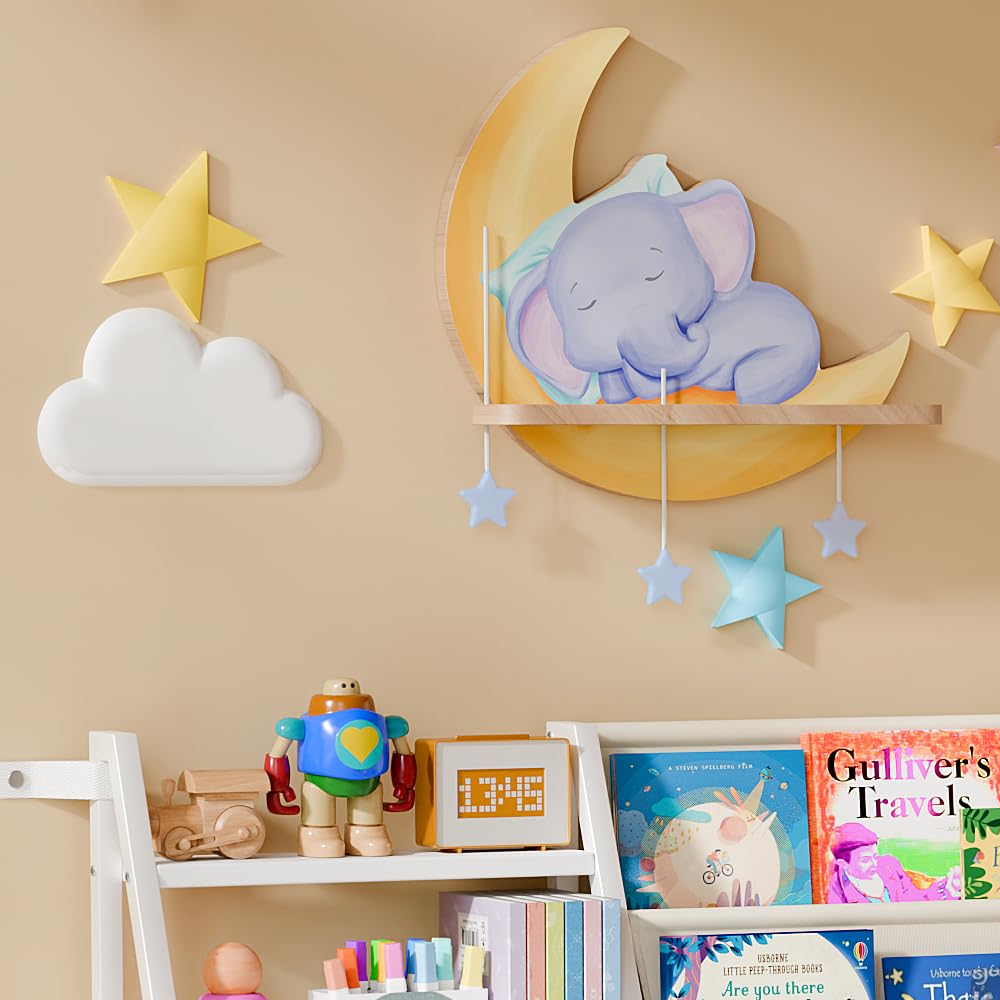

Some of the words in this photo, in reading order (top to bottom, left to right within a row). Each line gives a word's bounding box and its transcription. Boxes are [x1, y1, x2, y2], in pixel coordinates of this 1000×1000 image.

[827, 746, 991, 782] Gulliver's
[848, 784, 972, 819] Travels
[757, 953, 789, 963] USBORNE
[723, 966, 747, 976] LITTLE
[801, 963, 823, 973] BOOKS
[930, 967, 960, 978] Usborne
[721, 980, 749, 997] Are
[753, 984, 781, 1000] you
[785, 980, 825, 995] there
